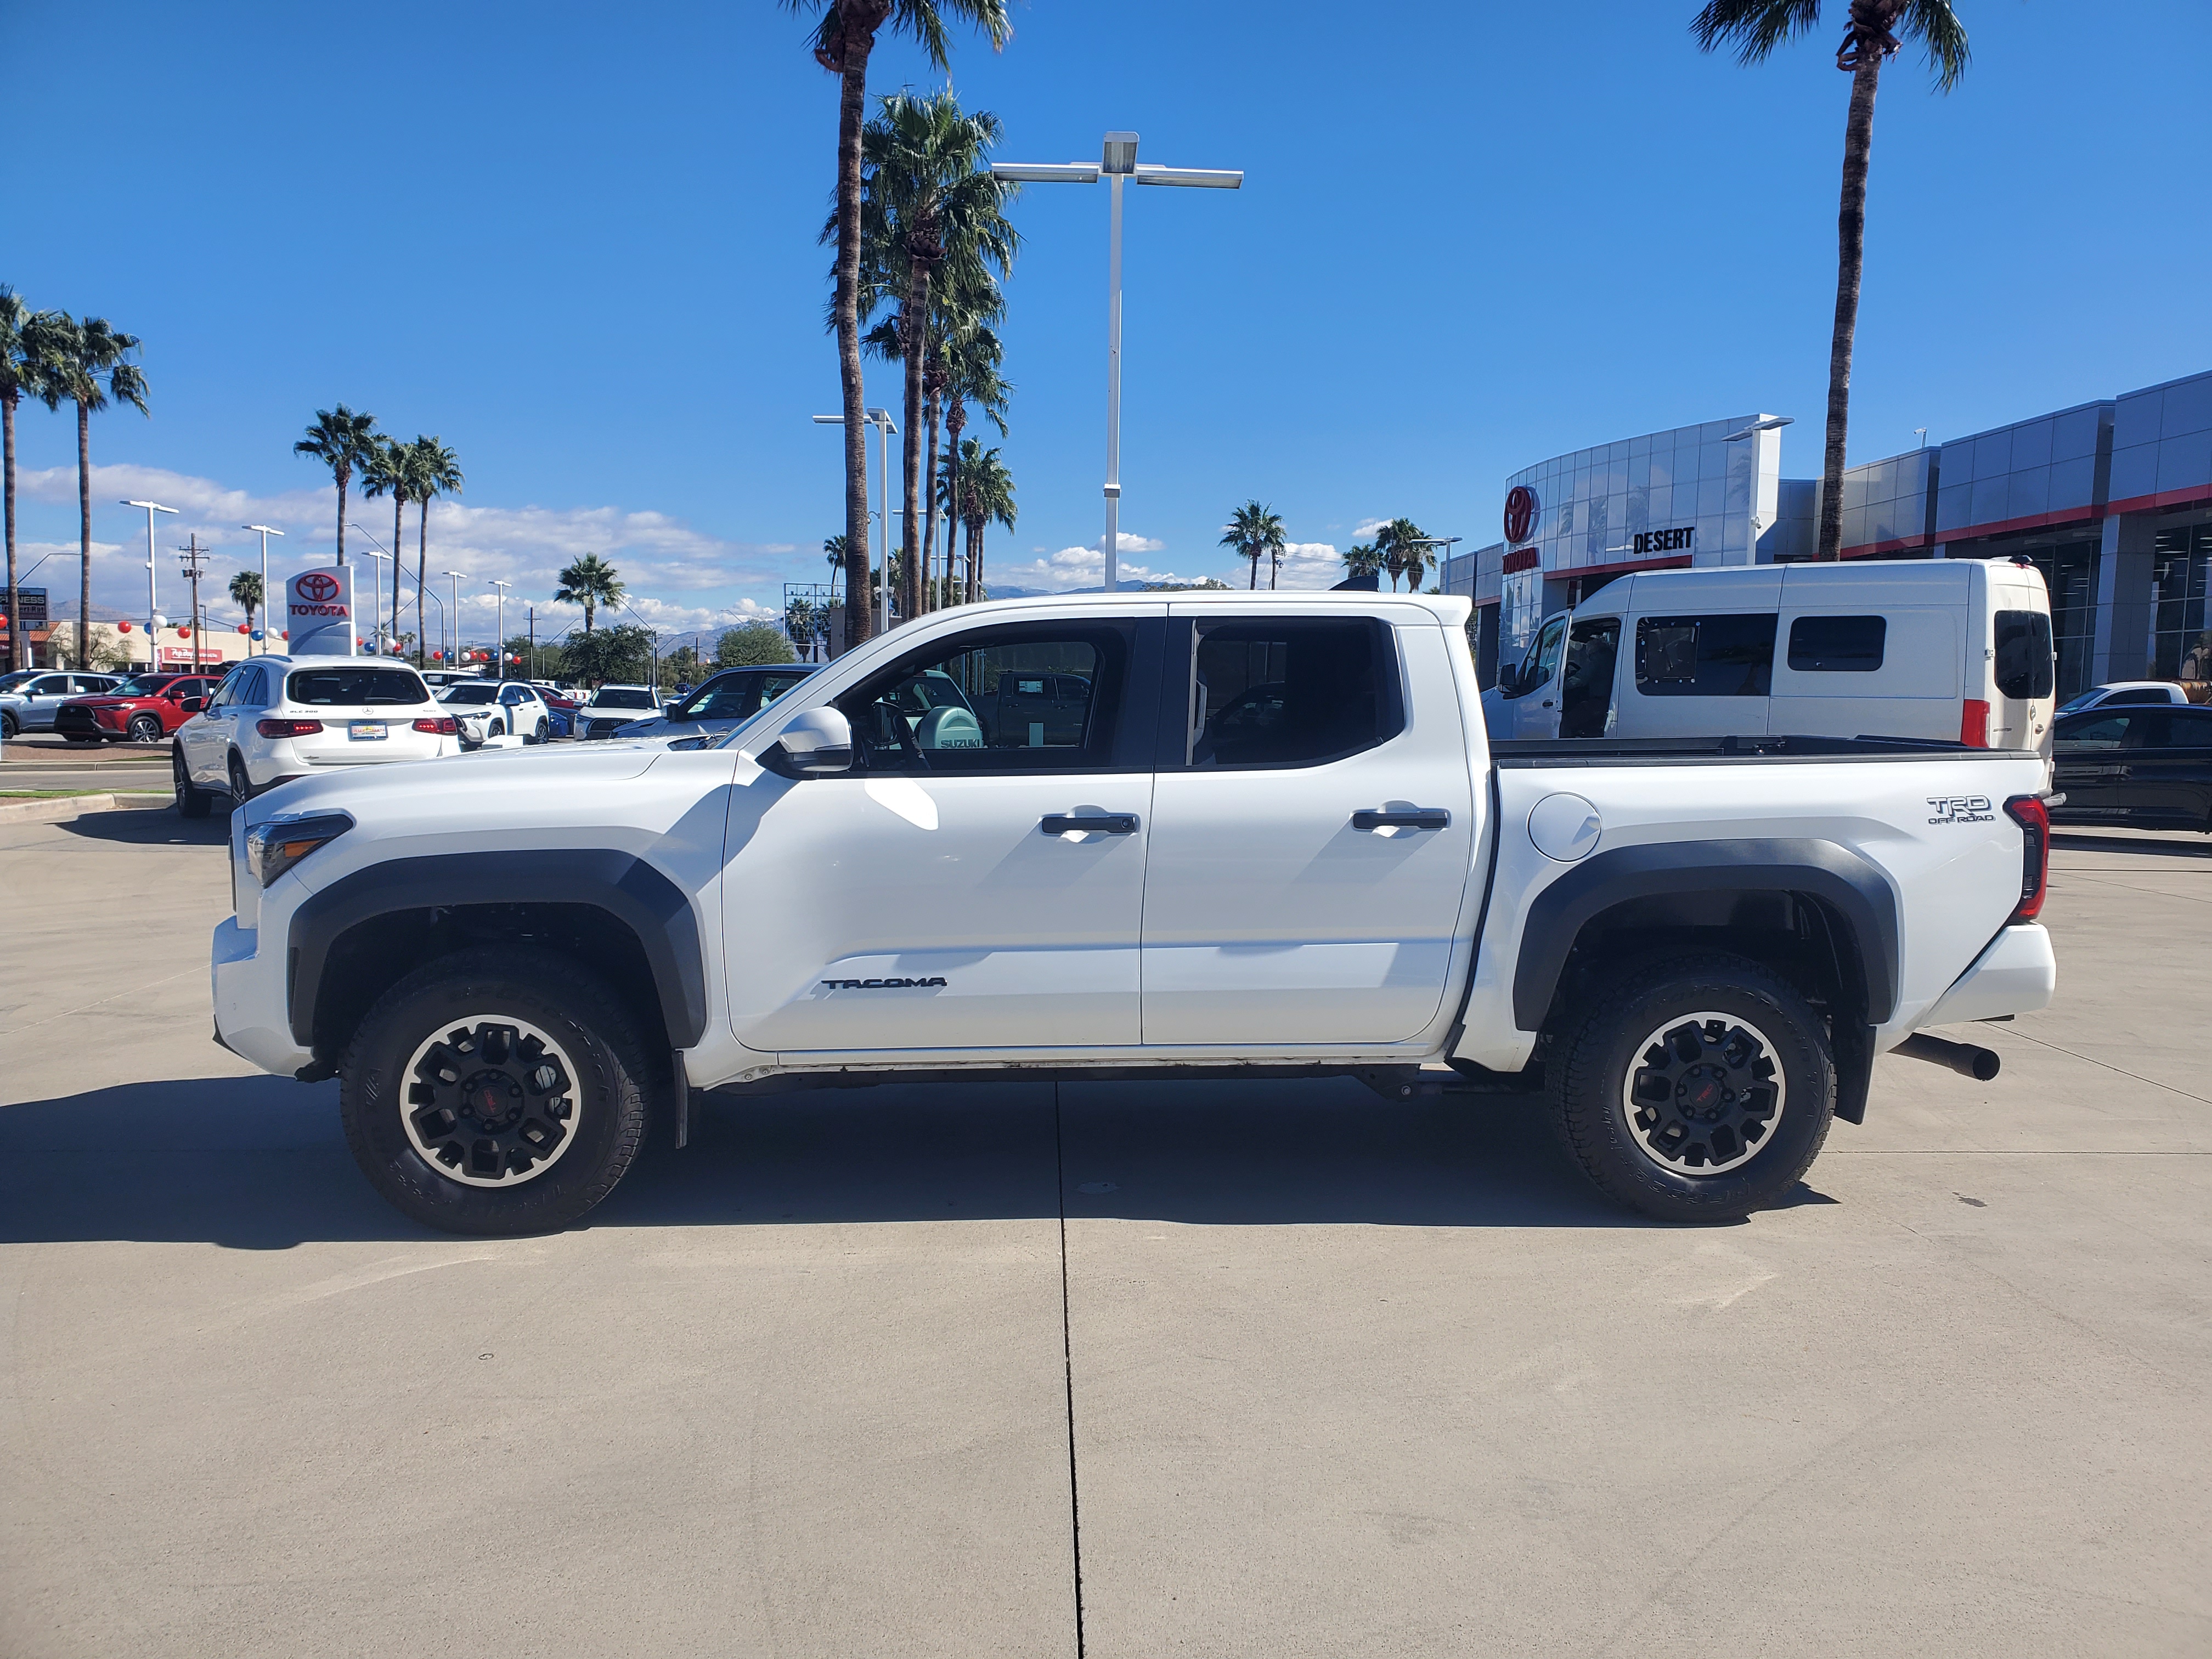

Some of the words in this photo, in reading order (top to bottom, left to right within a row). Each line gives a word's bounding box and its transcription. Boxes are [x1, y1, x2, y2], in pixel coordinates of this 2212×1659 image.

[1634, 527, 1695, 554] DESERT
[1502, 548, 1537, 574] TOYOTA
[289, 605, 348, 616] TOYOTA
[941, 739, 980, 748] SUZUKI
[1927, 795, 1992, 816] TRD
[1957, 815, 1996, 823] ROAD
[821, 977, 947, 989] TACOMA
